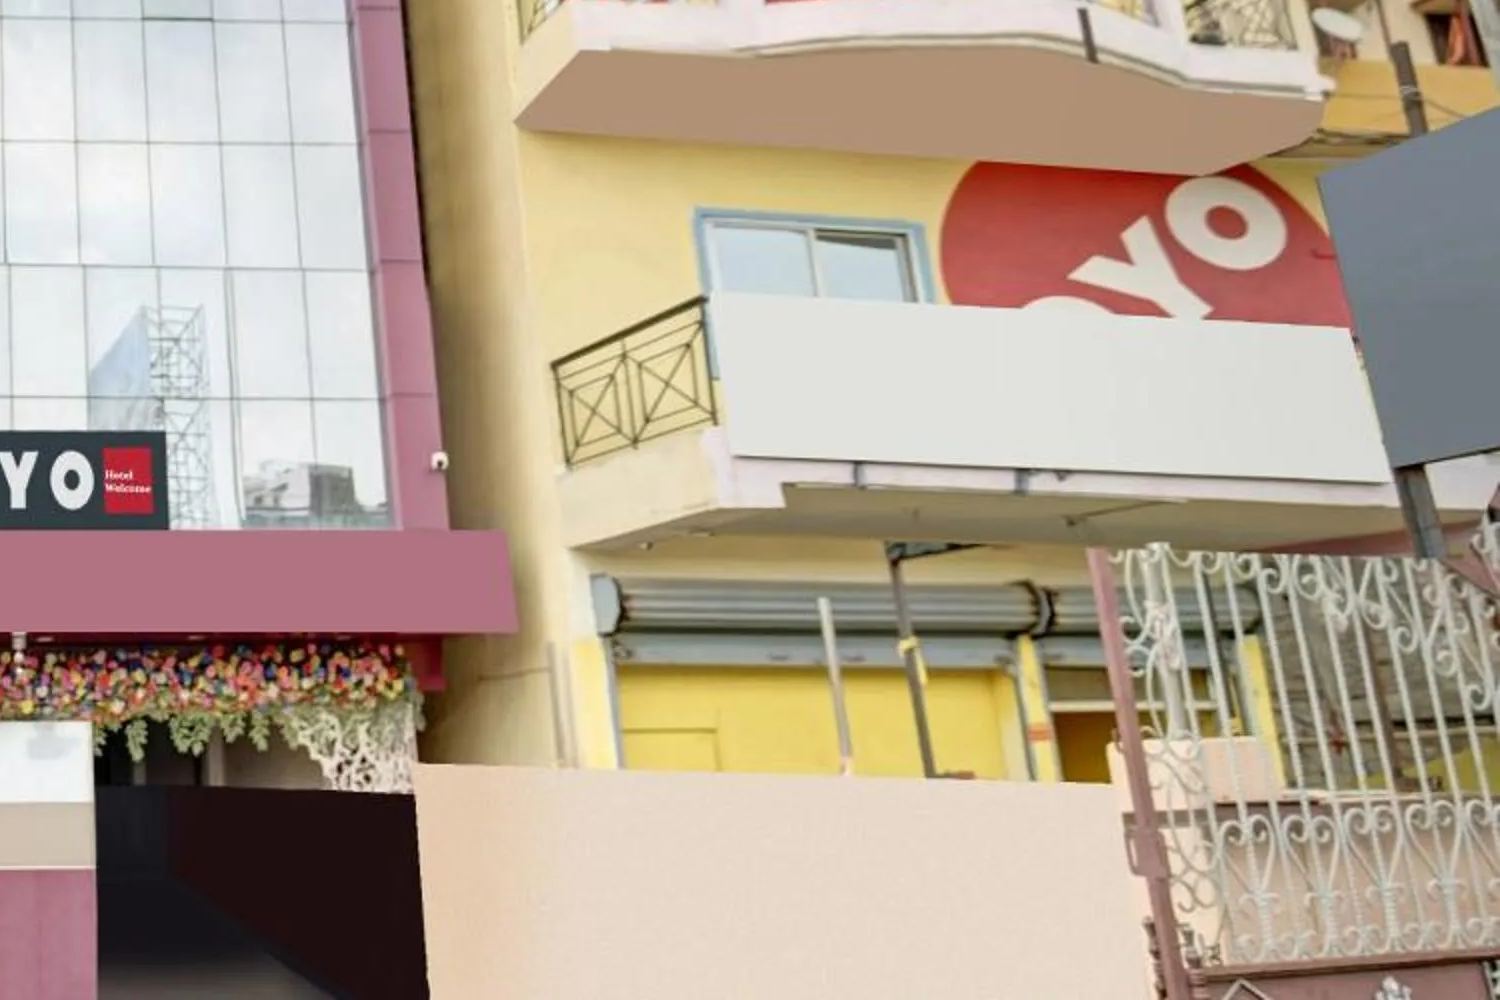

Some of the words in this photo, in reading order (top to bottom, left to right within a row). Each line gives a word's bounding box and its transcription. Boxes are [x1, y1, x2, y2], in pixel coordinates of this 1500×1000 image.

[1021, 176, 1288, 320] YO
[105, 469, 133, 480] Hotel
[105, 484, 151, 494] Welcome
